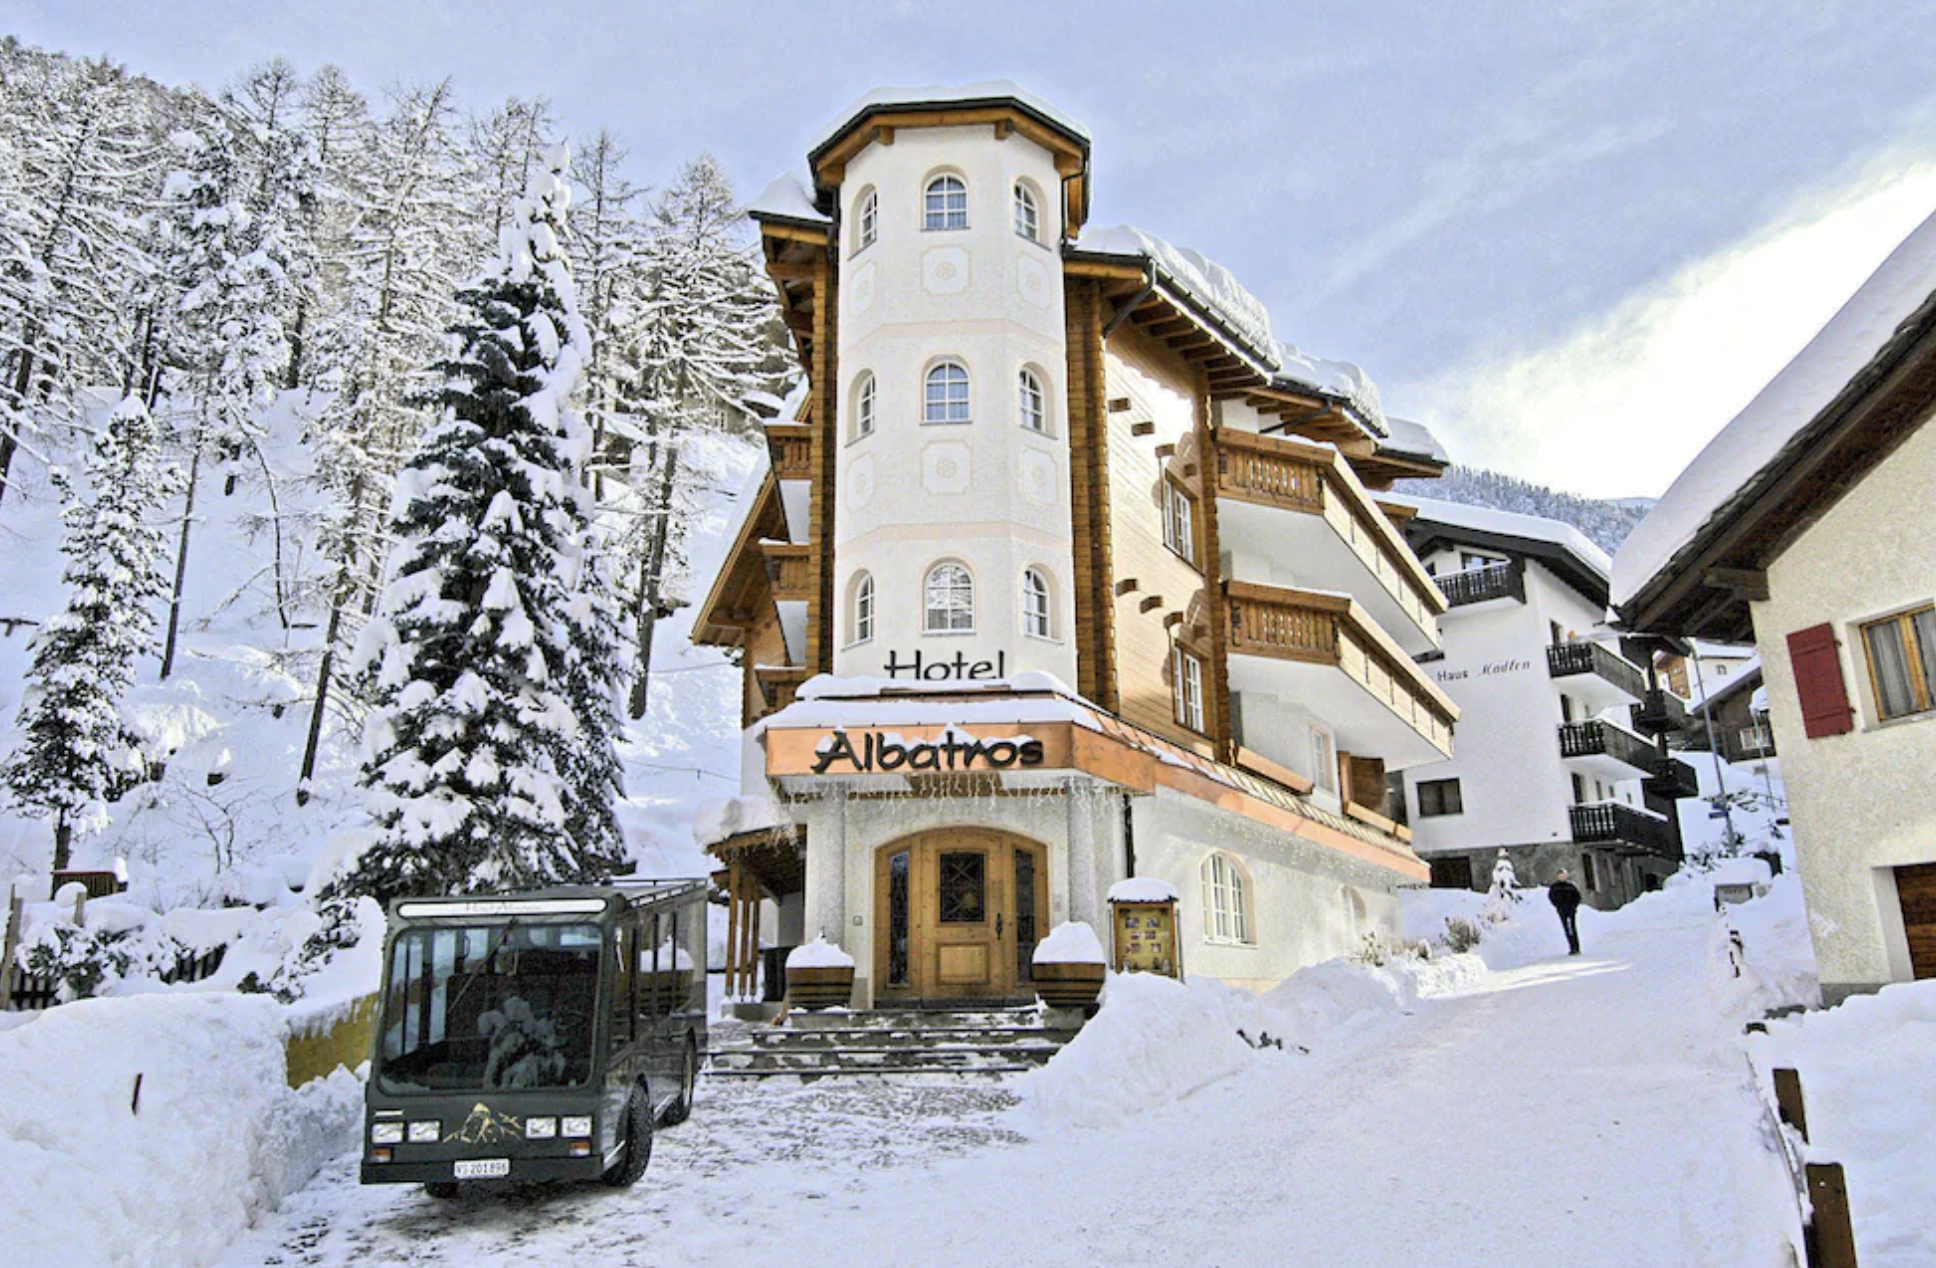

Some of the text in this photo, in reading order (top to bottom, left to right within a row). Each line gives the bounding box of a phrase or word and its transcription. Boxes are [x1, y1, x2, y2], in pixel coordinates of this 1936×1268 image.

[884, 650, 1005, 680] Hotel
[1437, 670, 1469, 683] Haus
[810, 729, 1044, 774] Albatros
